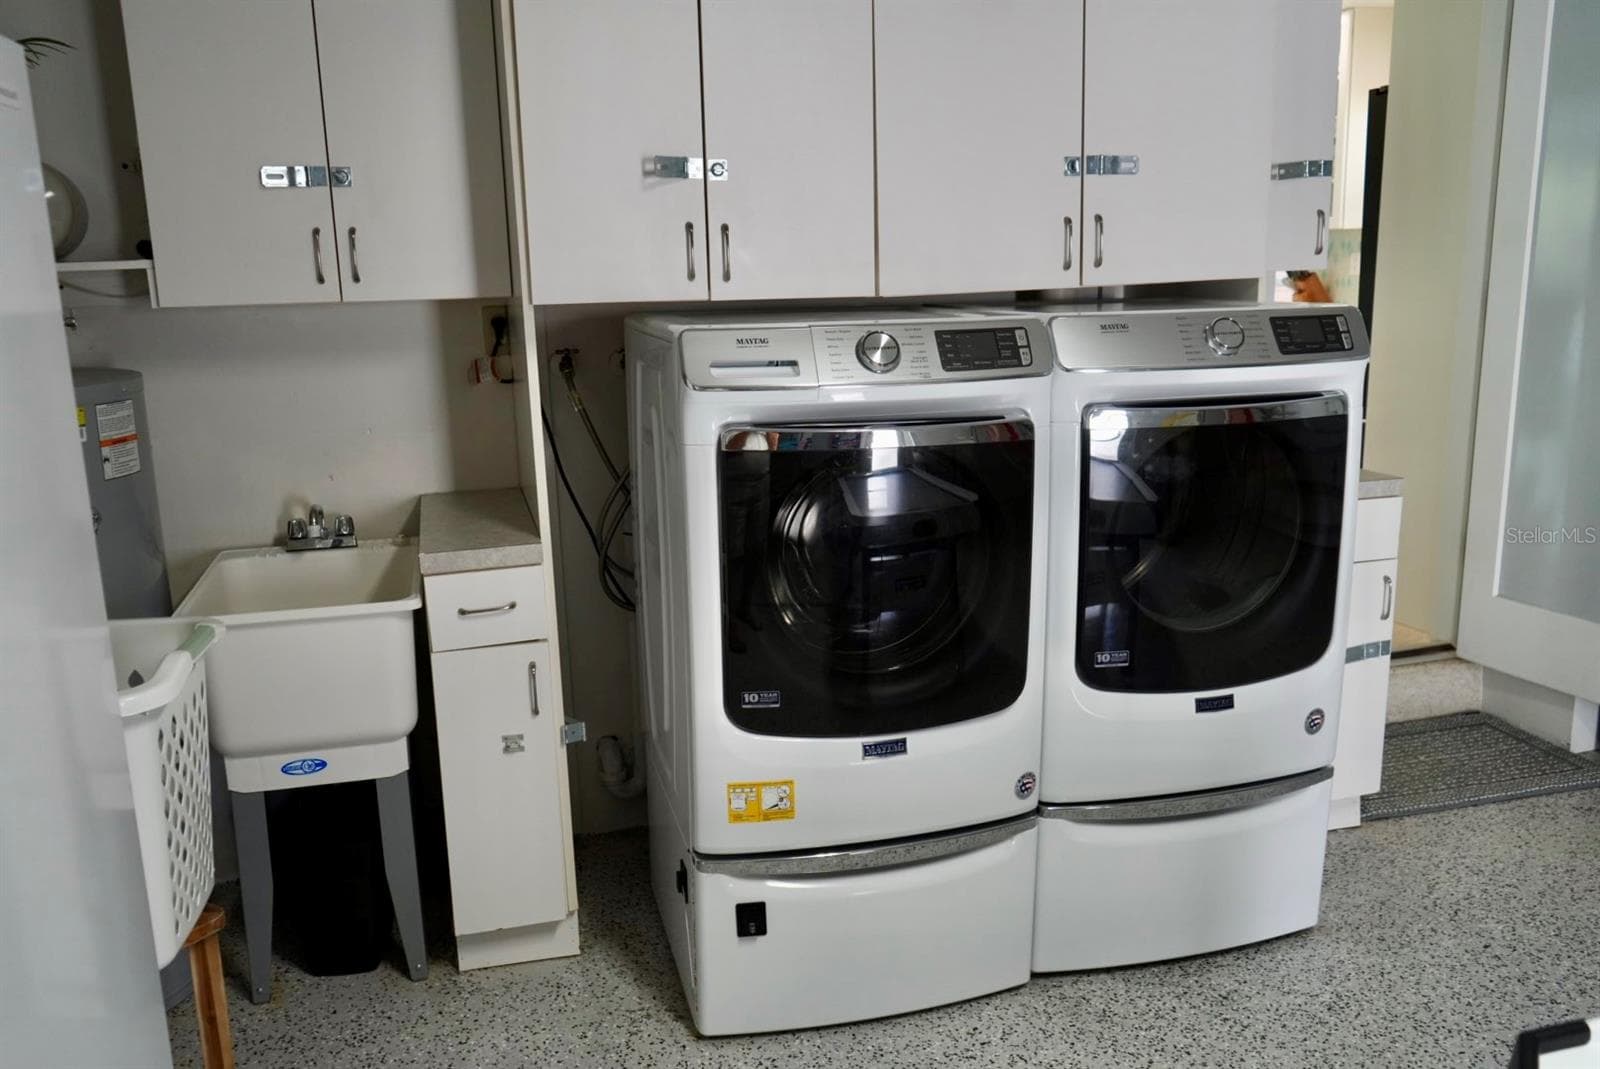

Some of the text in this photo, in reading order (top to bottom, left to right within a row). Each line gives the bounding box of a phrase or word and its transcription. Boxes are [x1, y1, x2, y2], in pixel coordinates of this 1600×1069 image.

[736, 337, 769, 345] MAYTAG
[1096, 653, 1110, 663] 10
[743, 693, 759, 703] 10
